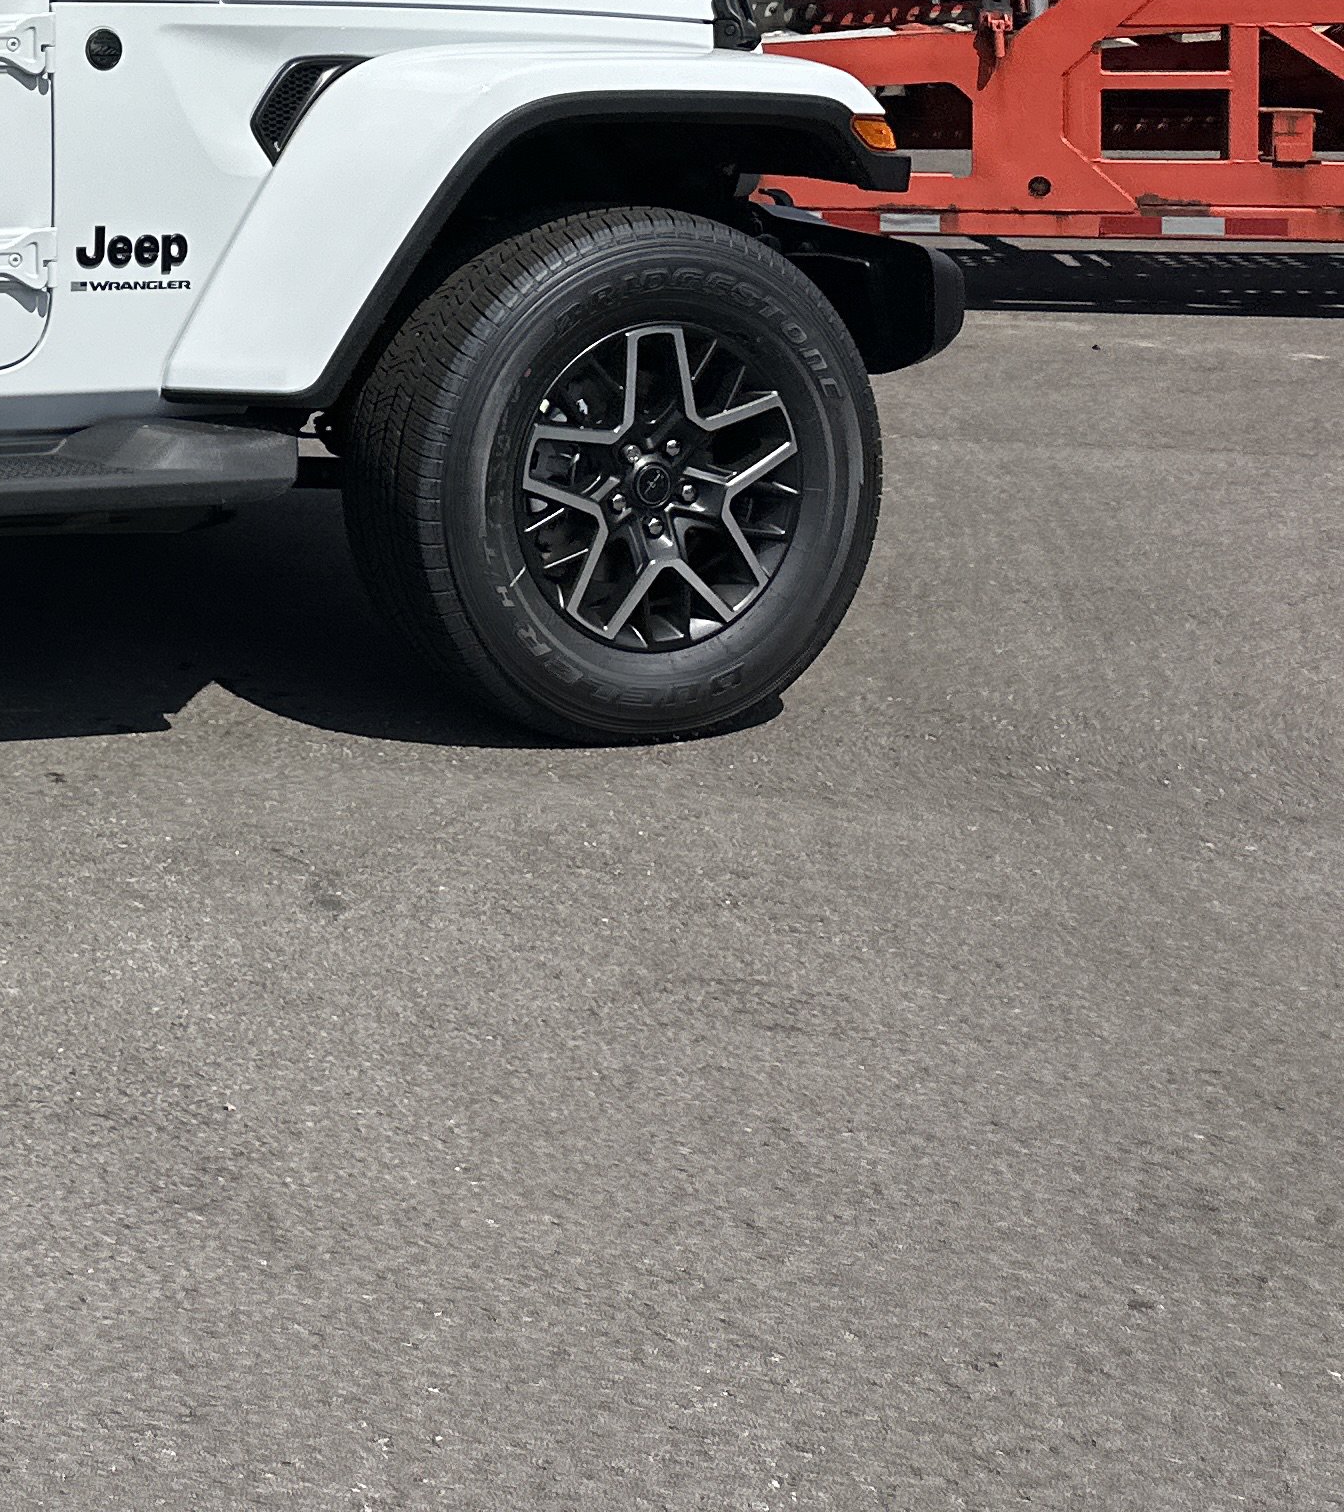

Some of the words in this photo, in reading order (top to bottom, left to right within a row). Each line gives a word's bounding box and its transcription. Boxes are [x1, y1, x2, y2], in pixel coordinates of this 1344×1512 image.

[75, 225, 189, 275] Jeep
[89, 280, 191, 291] WRANGLER
[553, 265, 845, 399] BRIDGESTONE
